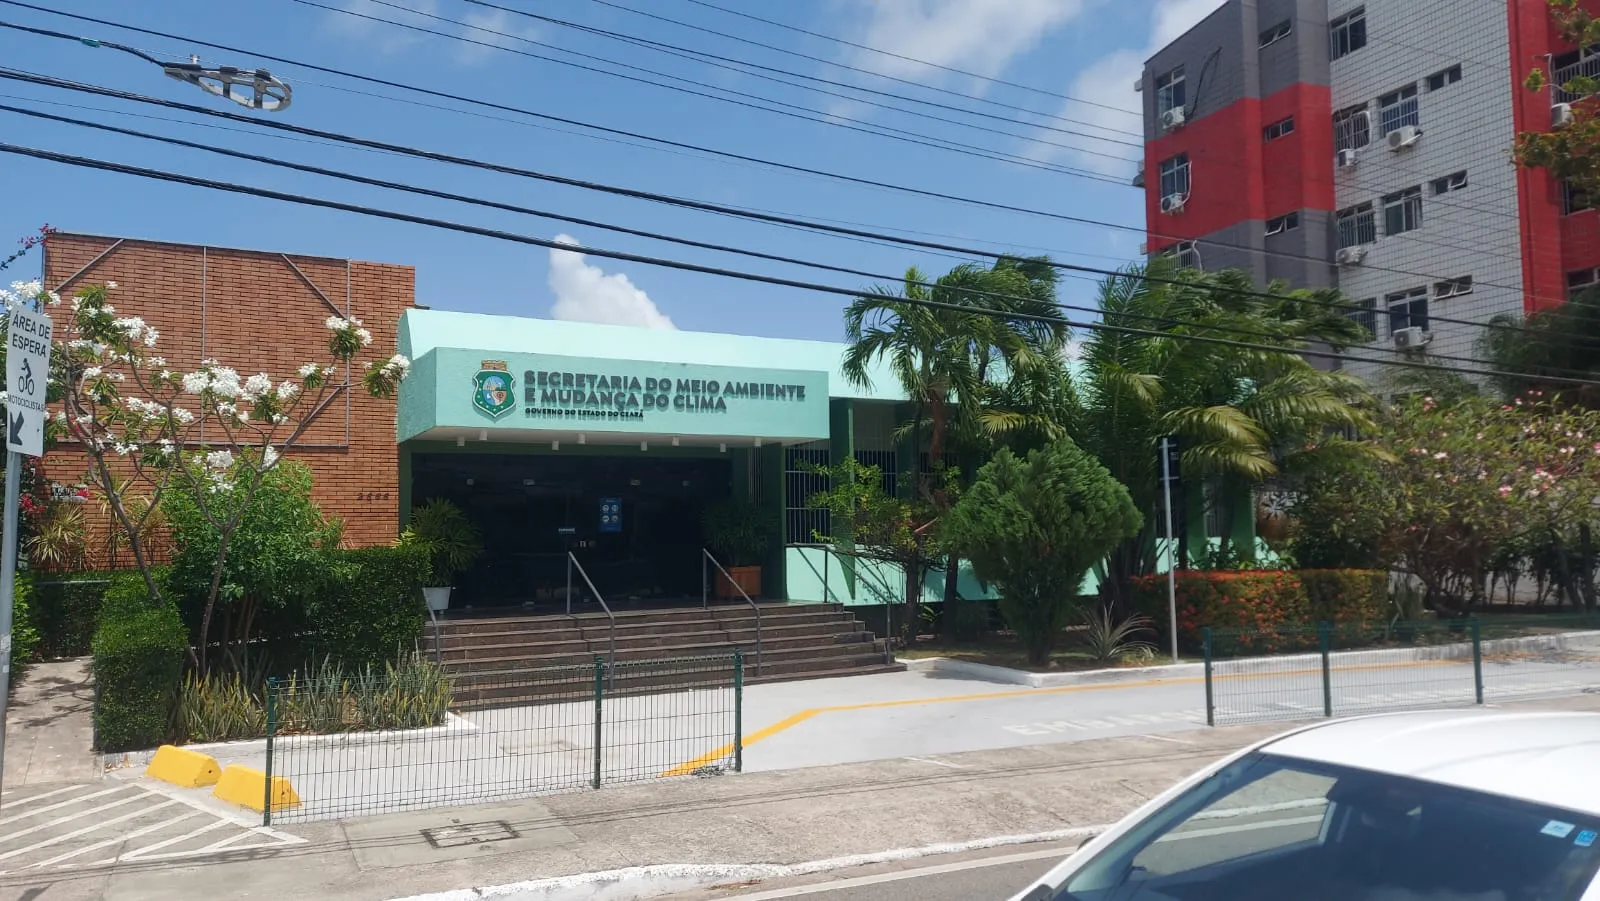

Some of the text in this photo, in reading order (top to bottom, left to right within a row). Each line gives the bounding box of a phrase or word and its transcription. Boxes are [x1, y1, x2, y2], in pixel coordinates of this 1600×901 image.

[12, 309, 50, 340] ÁREA DE
[12, 332, 46, 358] ESPERA
[523, 370, 806, 399] SECRETARIA DO MEIO AMBIENTE
[524, 387, 727, 410] E MUDANÇA DO CLIMA
[525, 407, 563, 415] GOVERNO
[577, 409, 606, 417] ESTADO
[620, 409, 644, 418] CEARÁ
